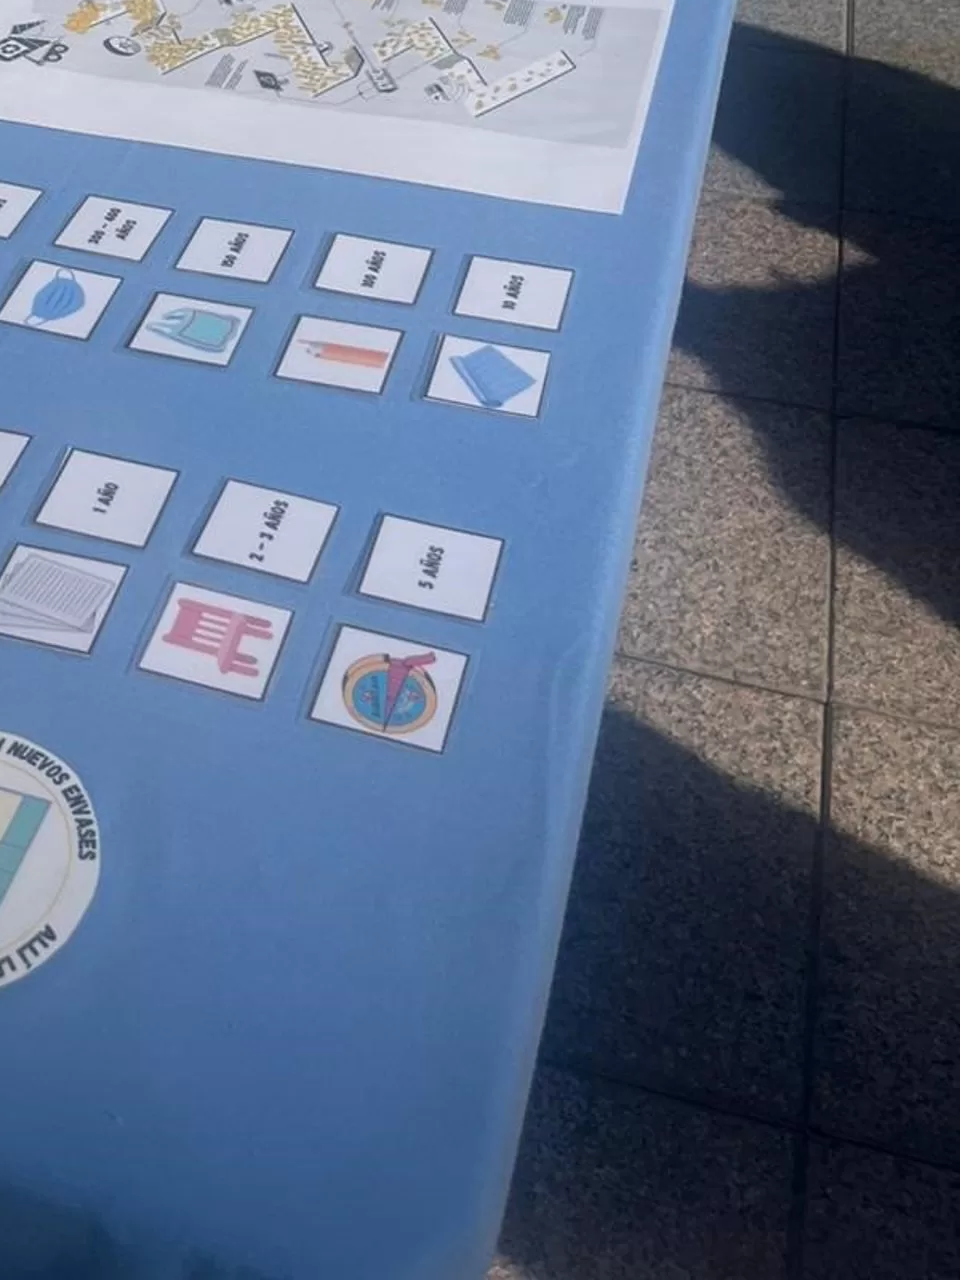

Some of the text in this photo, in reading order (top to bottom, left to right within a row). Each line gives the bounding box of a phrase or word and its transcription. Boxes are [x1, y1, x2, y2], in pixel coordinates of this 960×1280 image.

[115, 219, 137, 241] AÑOS
[228, 232, 250, 254] AÑOS
[365, 250, 387, 273] AÑOS
[503, 275, 525, 299] AÑOS
[92, 481, 120, 514] 1 AÑO
[263, 499, 289, 531] AÑOS
[259, 531, 274, 541] 3
[249, 552, 264, 563] 2
[418, 544, 445, 590] 5 AÑOS
[6, 741, 71, 786] NUEVOS
[61, 781, 97, 862] ENVASES
[16, 923, 58, 970] ALLÍ
